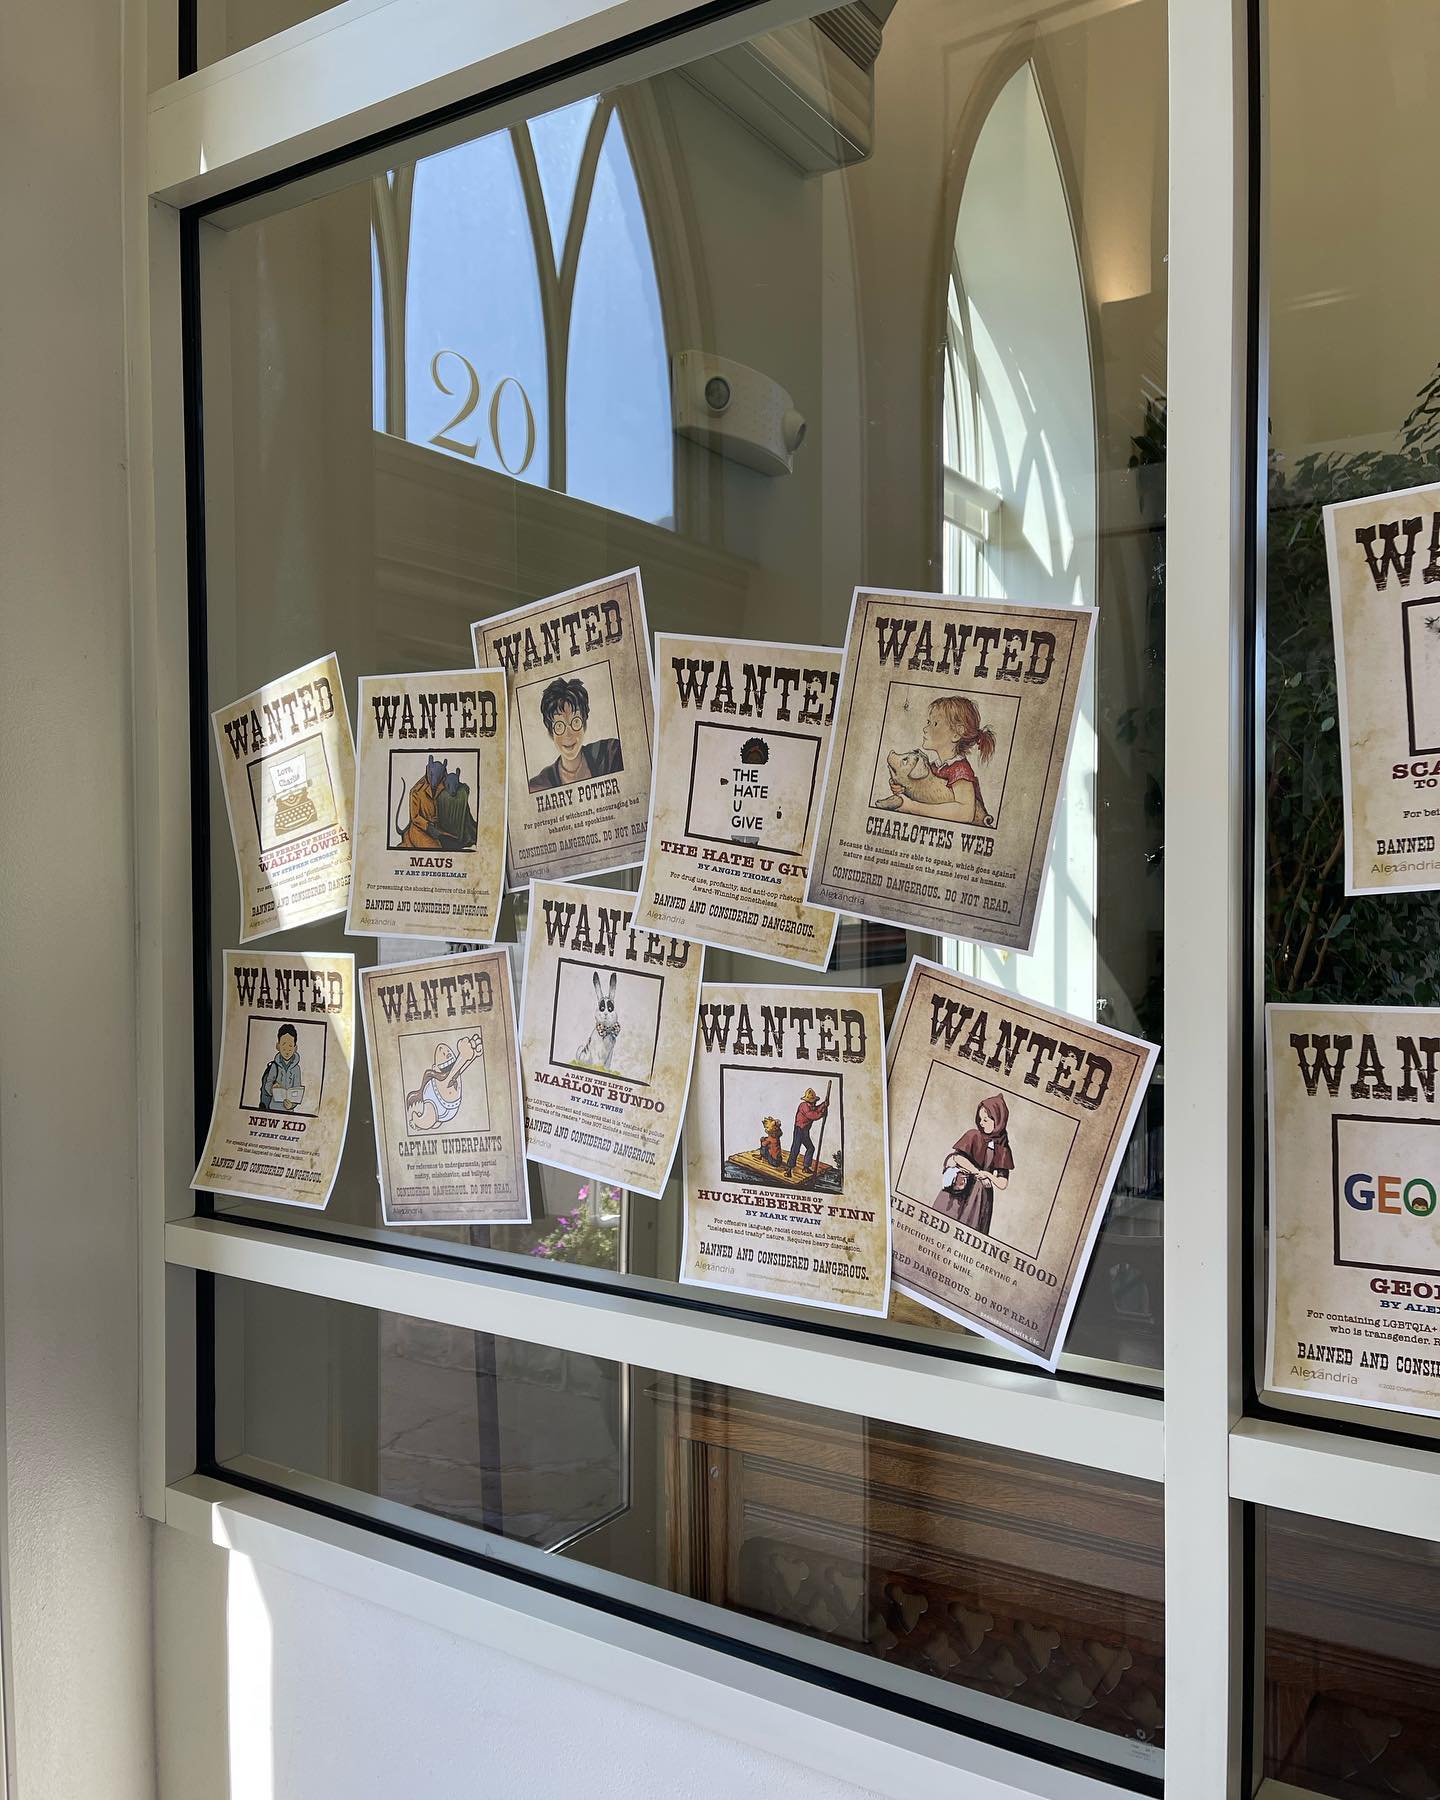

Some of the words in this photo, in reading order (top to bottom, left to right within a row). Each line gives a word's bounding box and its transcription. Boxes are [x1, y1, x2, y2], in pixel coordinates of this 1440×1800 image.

[428, 350, 536, 475] 20
[493, 600, 623, 672] WANTED
[876, 617, 1056, 684] WANTED
[224, 677, 335, 760] WANTED
[372, 690, 498, 739] WANTED
[733, 769, 758, 783] THE
[1414, 779, 1438, 788] TO
[536, 789, 573, 812] HARRY
[578, 778, 620, 802] POTTER
[734, 785, 768, 798] HATE
[734, 800, 742, 812] U
[1403, 810, 1422, 818] For
[1424, 809, 1440, 817] bei
[732, 816, 763, 830] GIVE
[865, 816, 954, 849] CHARLOTTES
[961, 833, 995, 857] WEB
[258, 832, 349, 872] WALLFLOWER
[519, 843, 557, 860] CONSIDERED
[560, 833, 601, 850] DANGEROUS.
[603, 830, 612, 841] DO
[615, 826, 629, 838] NOT
[1377, 836, 1435, 855] BANNED
[410, 857, 453, 868] MAUS
[661, 840, 698, 857] THE
[702, 848, 754, 868] HATE
[760, 859, 774, 871] U
[778, 862, 809, 879] GIV
[839, 839, 863, 850] Because
[864, 843, 874, 852] the
[875, 846, 898, 857] animals
[912, 852, 924, 862] able
[933, 858, 954, 868] speak,
[955, 862, 974, 873] which
[976, 867, 991, 876] goes
[992, 869, 1016, 880] against
[843, 851, 863, 860] nature
[864, 854, 875, 863] and
[876, 857, 889, 866] puts
[890, 859, 914, 870] animals
[925, 865, 935, 875] the
[936, 870, 953, 878] same
[954, 871, 969, 882] level
[980, 877, 1007, 889] humans.
[1371, 860, 1440, 875] Alexandria
[681, 873, 695, 883] drug
[697, 877, 708, 885] use,
[709, 880, 739, 892] profanity,
[740, 885, 751, 893] and
[752, 888, 778, 900] anti-cop
[713, 865, 740, 877] ANGIE
[742, 872, 782, 885] THOMAS
[693, 886, 739, 900] Award-Winning
[740, 895, 778, 907] nonetheless.
[820, 887, 865, 905] Alexandria
[832, 866, 883, 886] CONSIDERED
[886, 877, 941, 900] DANGEROUS.
[945, 889, 957, 902] DO
[960, 893, 980, 908] NOT
[983, 898, 1011, 914] READ.
[252, 901, 275, 917] BANNED
[365, 899, 394, 911] BANNED
[397, 901, 410, 912] AND
[414, 902, 450, 914] CONSIDERED
[453, 904, 488, 917] DANGEROUS.
[647, 910, 685, 925] Alexandria
[653, 893, 686, 910] BANNED
[688, 901, 706, 914] AND
[709, 904, 759, 926] CONSIDERED
[762, 916, 815, 938] DANGEROUS.
[234, 967, 343, 1013] WANTED
[378, 971, 493, 1023] WANTED
[700, 1004, 867, 1064] WANTED
[930, 993, 1113, 1111] WANTED
[570, 1074, 584, 1082] DAY
[594, 1078, 607, 1086] THE
[608, 1082, 623, 1090] LIFE
[1290, 1033, 1440, 1103] WAN
[534, 1072, 605, 1097] MARLON
[607, 1088, 664, 1113] BUNDO
[582, 1098, 599, 1107] JILL
[600, 1103, 623, 1113] TWISS
[248, 1116, 280, 1129] NEW
[282, 1120, 306, 1132] KID
[258, 1132, 278, 1140] JERRY
[399, 1139, 437, 1157] CAPTAIN
[442, 1136, 503, 1155] UNDERPANTS
[525, 1117, 552, 1135] BANNED
[554, 1126, 569, 1139] AND
[571, 1130, 612, 1151] CONSIDERED
[613, 1142, 656, 1165] DANGEROUS.
[698, 1189, 824, 1214] HUCKLEBERRY
[828, 1206, 875, 1222] FINN
[759, 1190, 811, 1201] ADVENTURES
[1344, 1173, 1437, 1217] GEO
[745, 1209, 758, 1217] BY
[759, 1211, 788, 1221] MARK
[790, 1216, 821, 1226] TWAIN
[891, 1196, 915, 1218] TLE
[918, 1210, 950, 1234] RED
[953, 1226, 1011, 1265] RIDING
[1013, 1256, 1057, 1288] HOOD
[896, 1222, 935, 1246] DEPICTIONS
[937, 1241, 946, 1250] OF
[954, 1249, 974, 1265] CHILD
[975, 1261, 1011, 1282] CARRYING
[694, 1260, 734, 1275] Alexandria
[700, 1241, 733, 1258] BANNED
[737, 1247, 754, 1262] AND
[758, 1250, 809, 1271] CONSIDERED
[813, 1258, 869, 1280] DANGEROUS.
[918, 1244, 940, 1261] BOTTLE
[943, 1257, 951, 1266] OF
[953, 1261, 973, 1278] WINE.
[913, 1260, 971, 1298] DANGEROUS.
[975, 1292, 989, 1304] DO
[989, 1300, 1010, 1316] NOT
[1011, 1310, 1040, 1333] READ.
[1380, 1300, 1401, 1309] BY
[1306, 1310, 1324, 1319] For
[1327, 1312, 1381, 1327] containing
[1383, 1319, 1437, 1333] LGBTQIA+
[1330, 1325, 1350, 1335] who
[1354, 1328, 1362, 1336] is
[1365, 1329, 1430, 1345] transgender.
[1298, 1342, 1353, 1365] BANNED
[1360, 1351, 1389, 1370] AND
[1290, 1365, 1358, 1385] Alexandria
